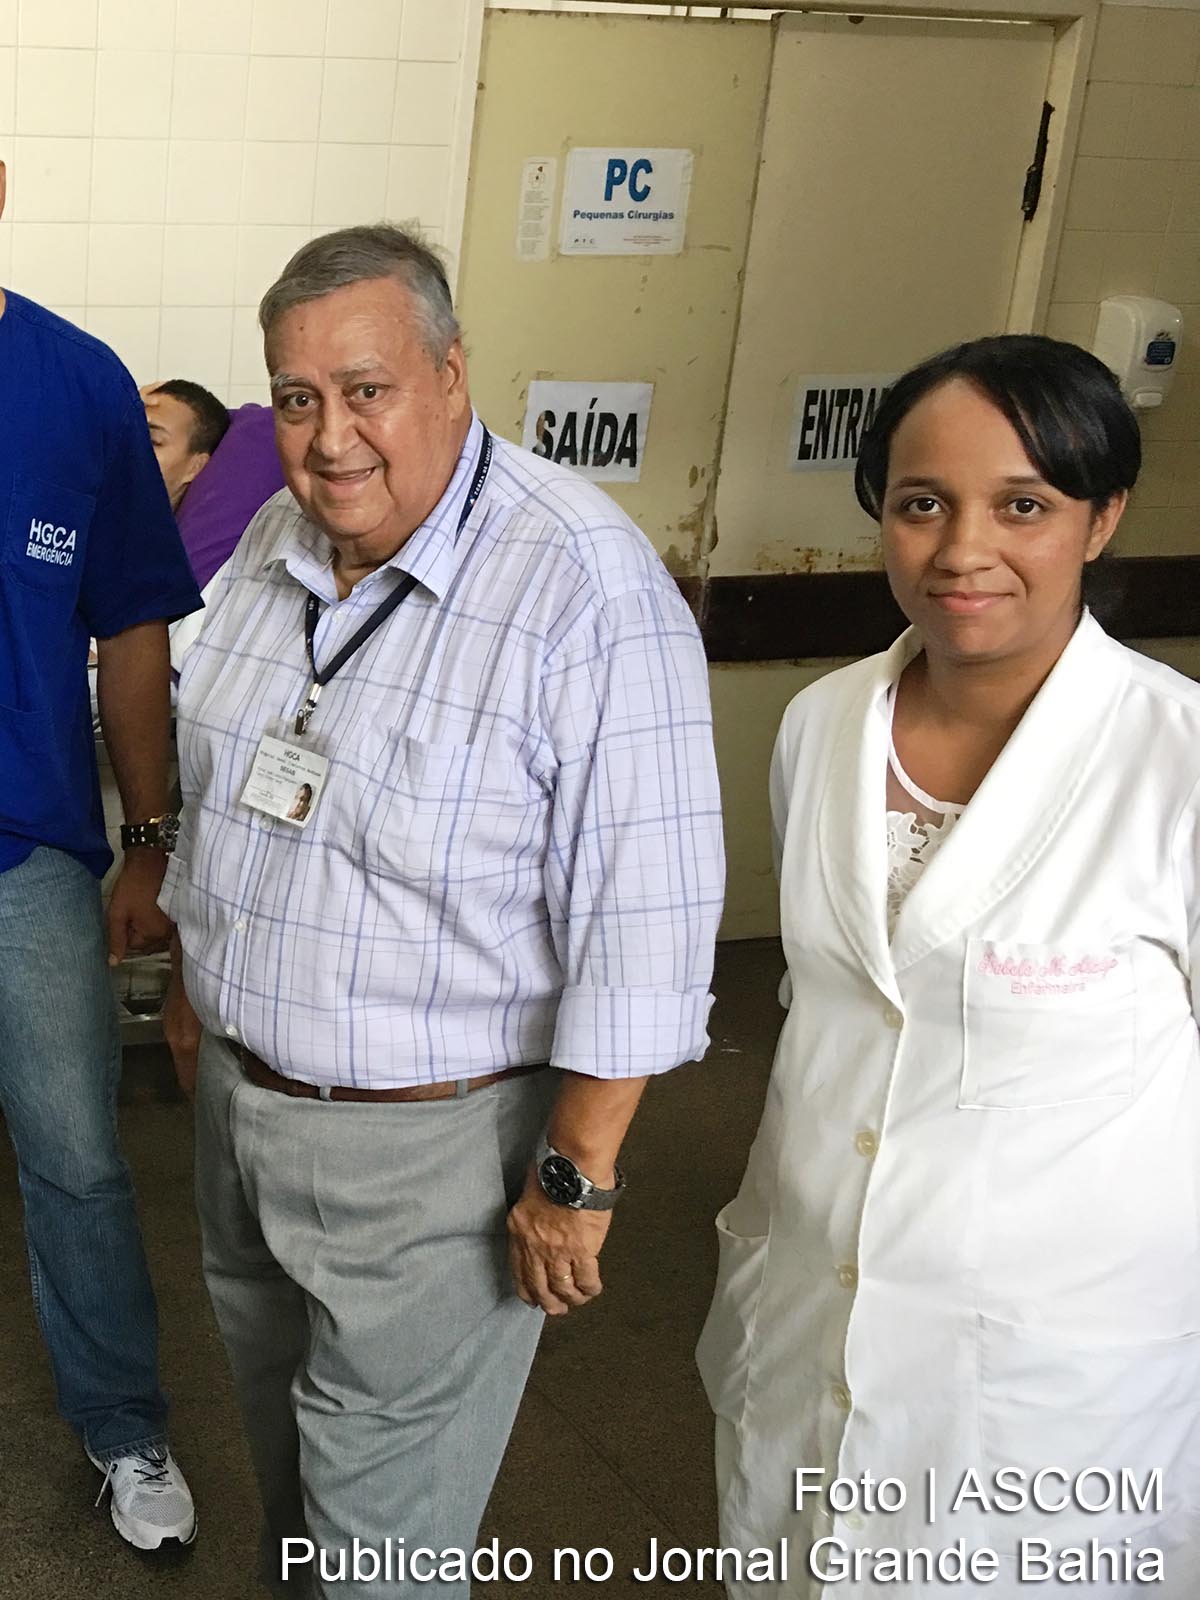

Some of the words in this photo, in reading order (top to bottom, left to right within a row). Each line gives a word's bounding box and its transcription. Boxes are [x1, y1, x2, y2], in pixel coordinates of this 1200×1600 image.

[604, 158, 653, 202] PC
[573, 209, 625, 222] Pequenas
[627, 209, 675, 222] Cirurgias
[532, 397, 638, 468] SAÍDA
[798, 388, 890, 460] ENTRA
[29, 518, 77, 551] HGCA
